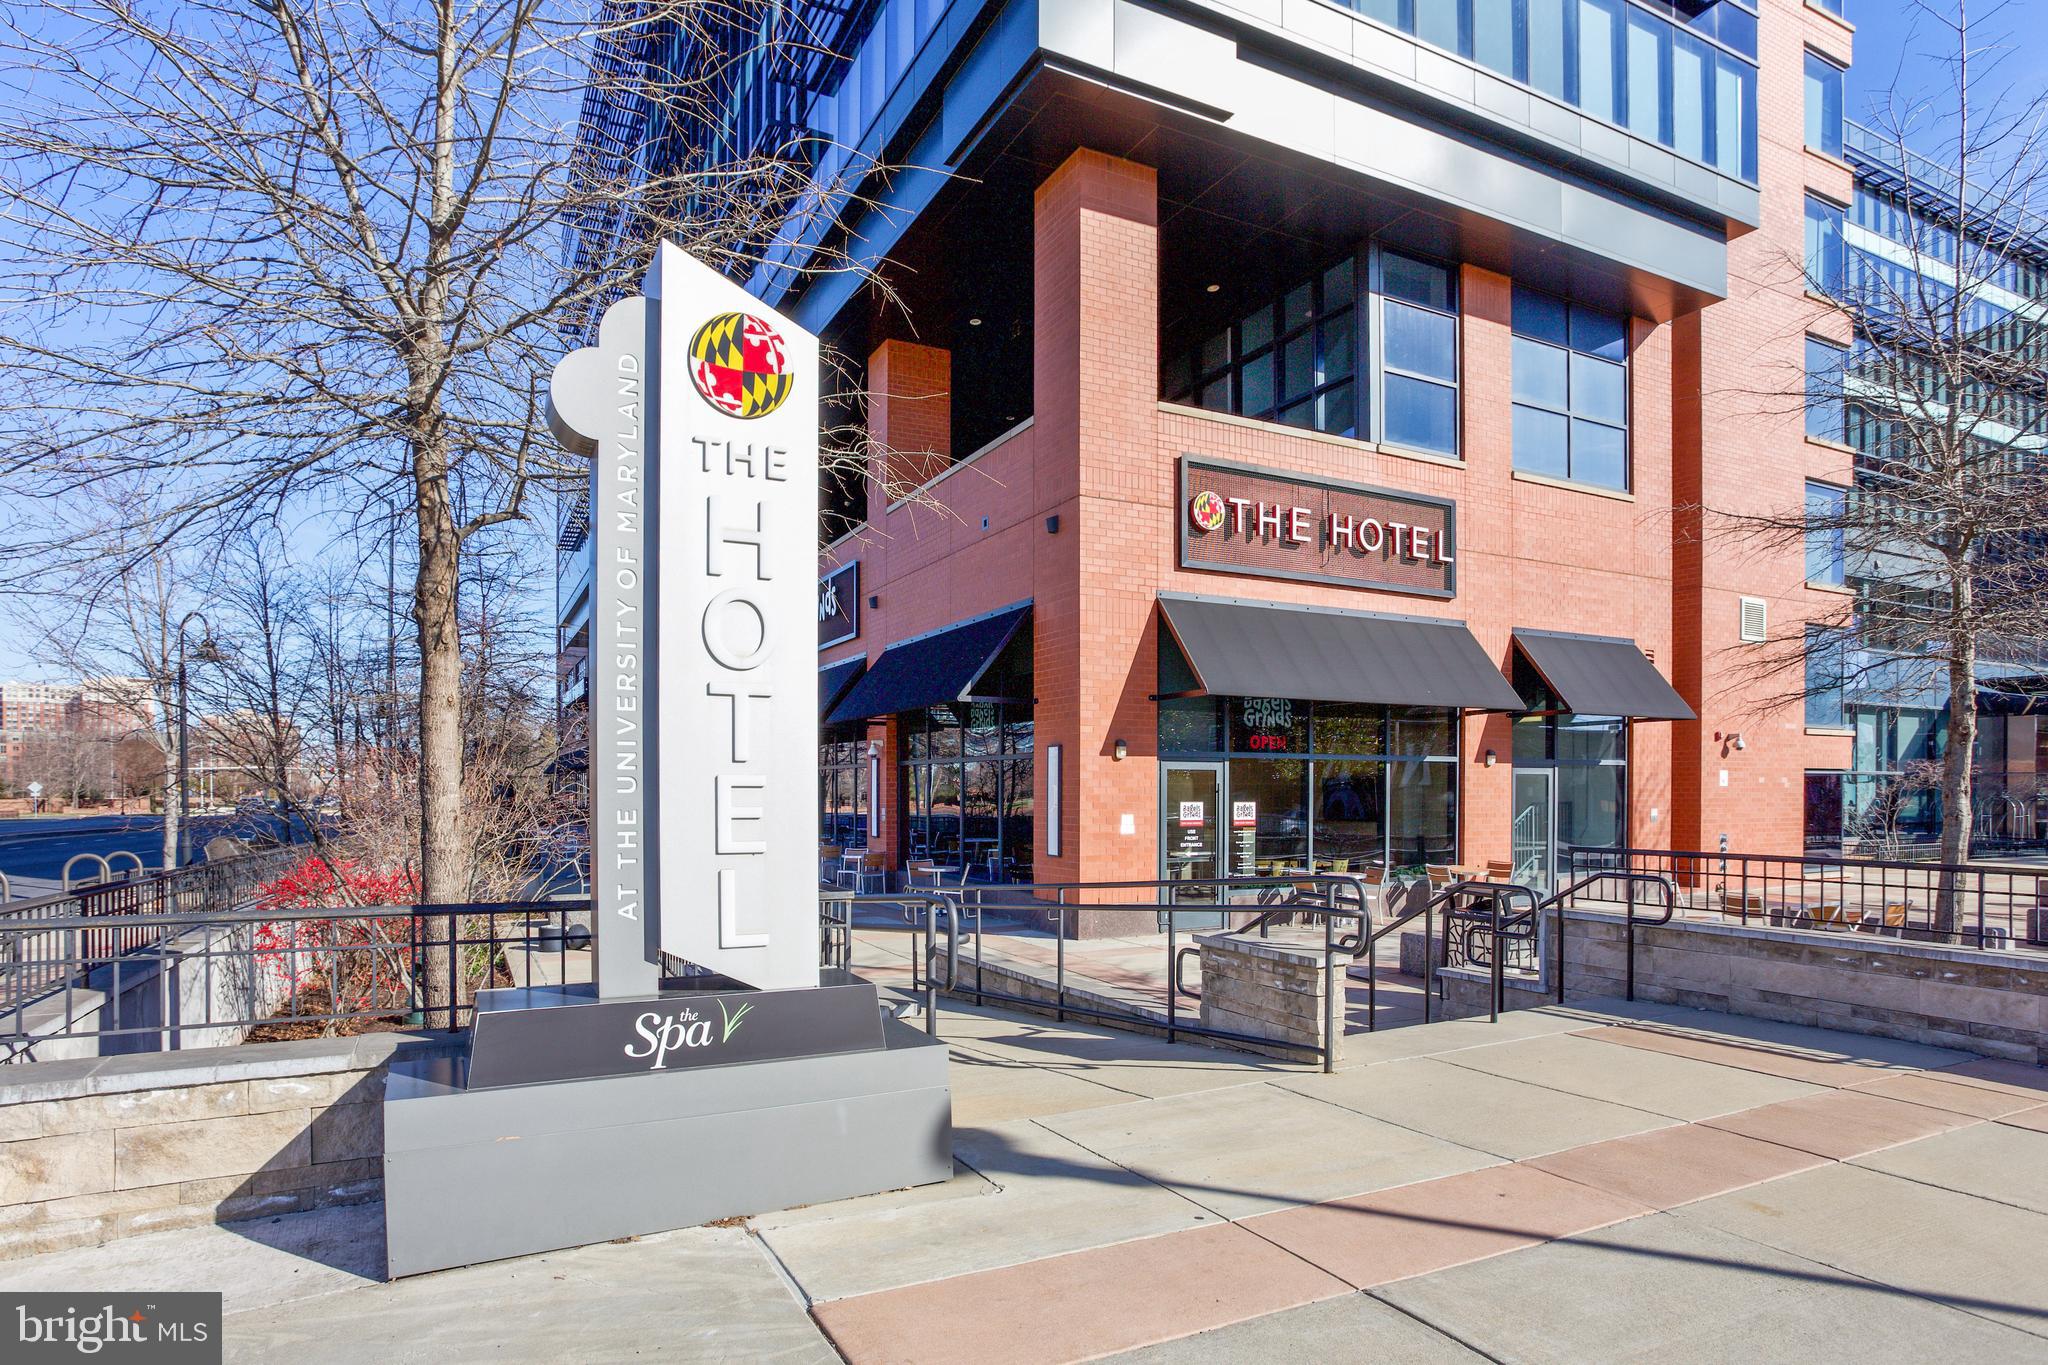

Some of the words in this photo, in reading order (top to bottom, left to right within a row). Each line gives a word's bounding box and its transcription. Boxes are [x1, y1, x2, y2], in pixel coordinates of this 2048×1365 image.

[616, 353, 640, 533] MARYLAND
[691, 435, 788, 482] THE
[1226, 498, 1312, 542] THE
[1330, 512, 1454, 562] HOTEL
[616, 547, 638, 590] OF
[616, 598, 638, 795] UNIVERSITY
[701, 495, 774, 950] HOTEL
[1250, 735, 1287, 749] OPEN
[617, 808, 639, 869] THE
[617, 884, 639, 921] AT
[624, 1012, 713, 1070] Spa
[680, 1008, 698, 1021] the
